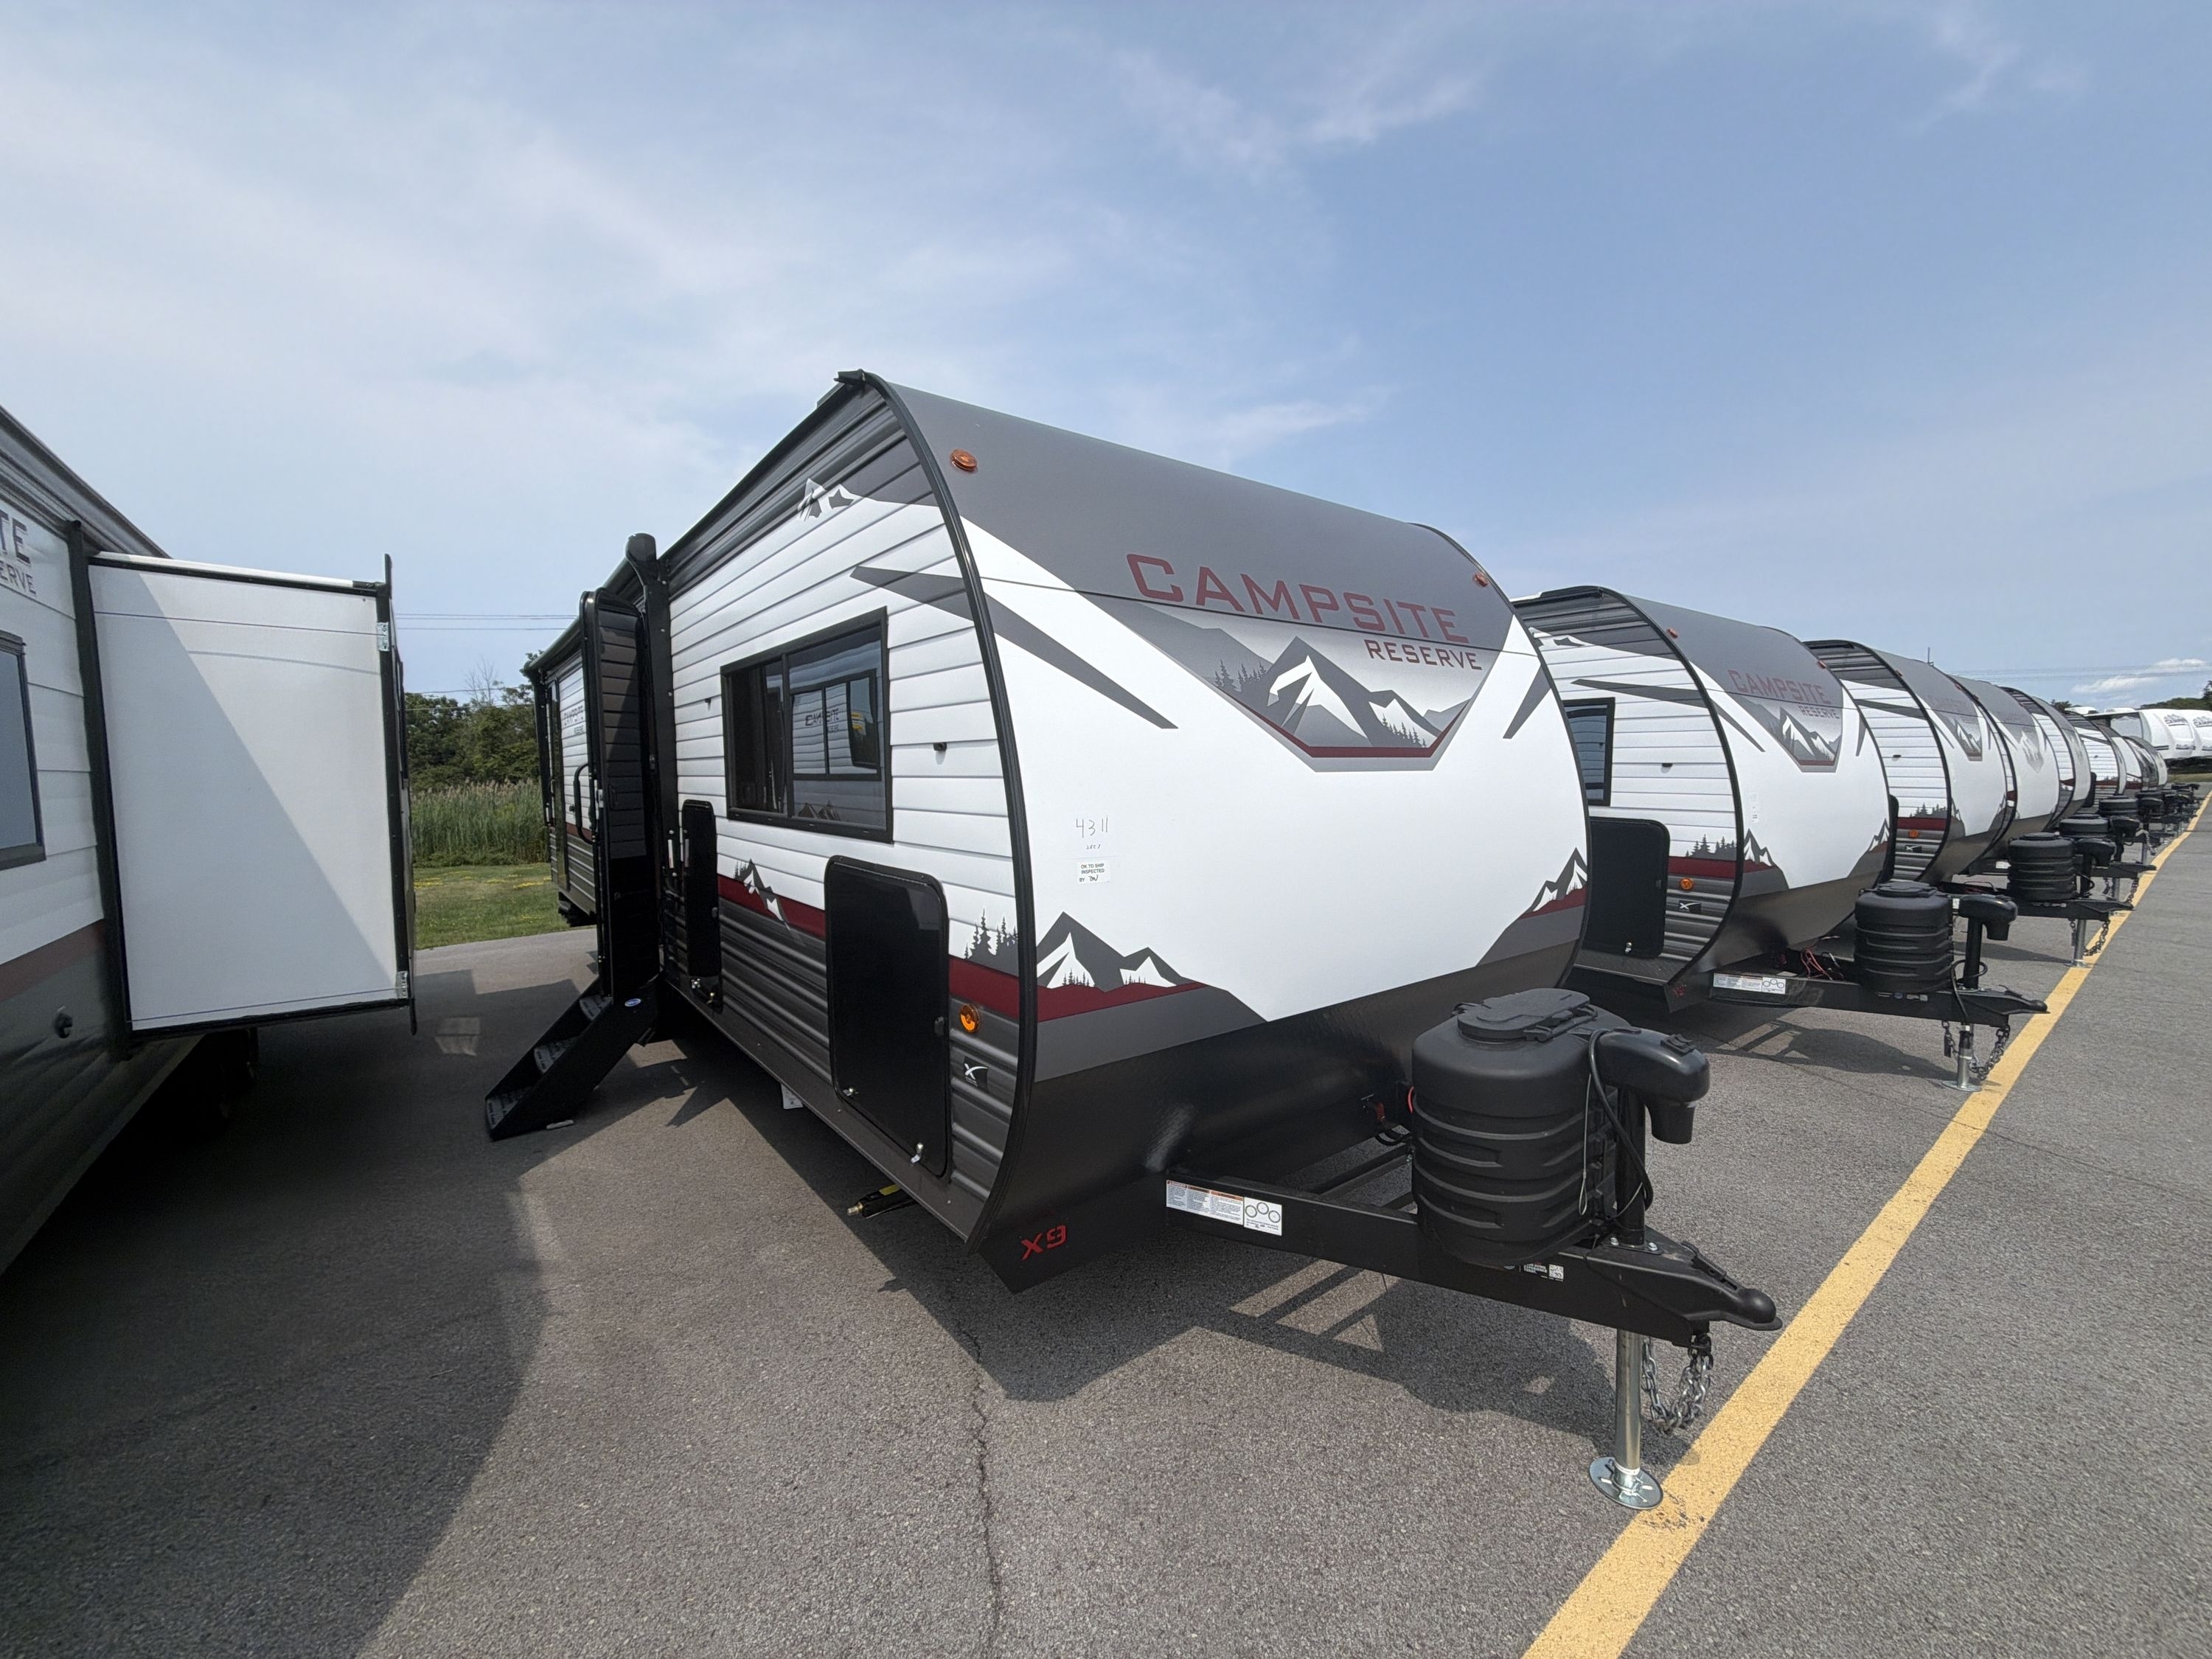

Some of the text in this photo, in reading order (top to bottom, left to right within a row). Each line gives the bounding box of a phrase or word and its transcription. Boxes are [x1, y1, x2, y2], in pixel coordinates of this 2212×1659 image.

[1127, 553, 1469, 644] CAMPSITE
[1364, 639, 1483, 671] RESERVE
[1728, 669, 1832, 705] CAMPSITE
[1798, 706, 1840, 720] RESERVE
[1076, 815, 1108, 838] 4311
